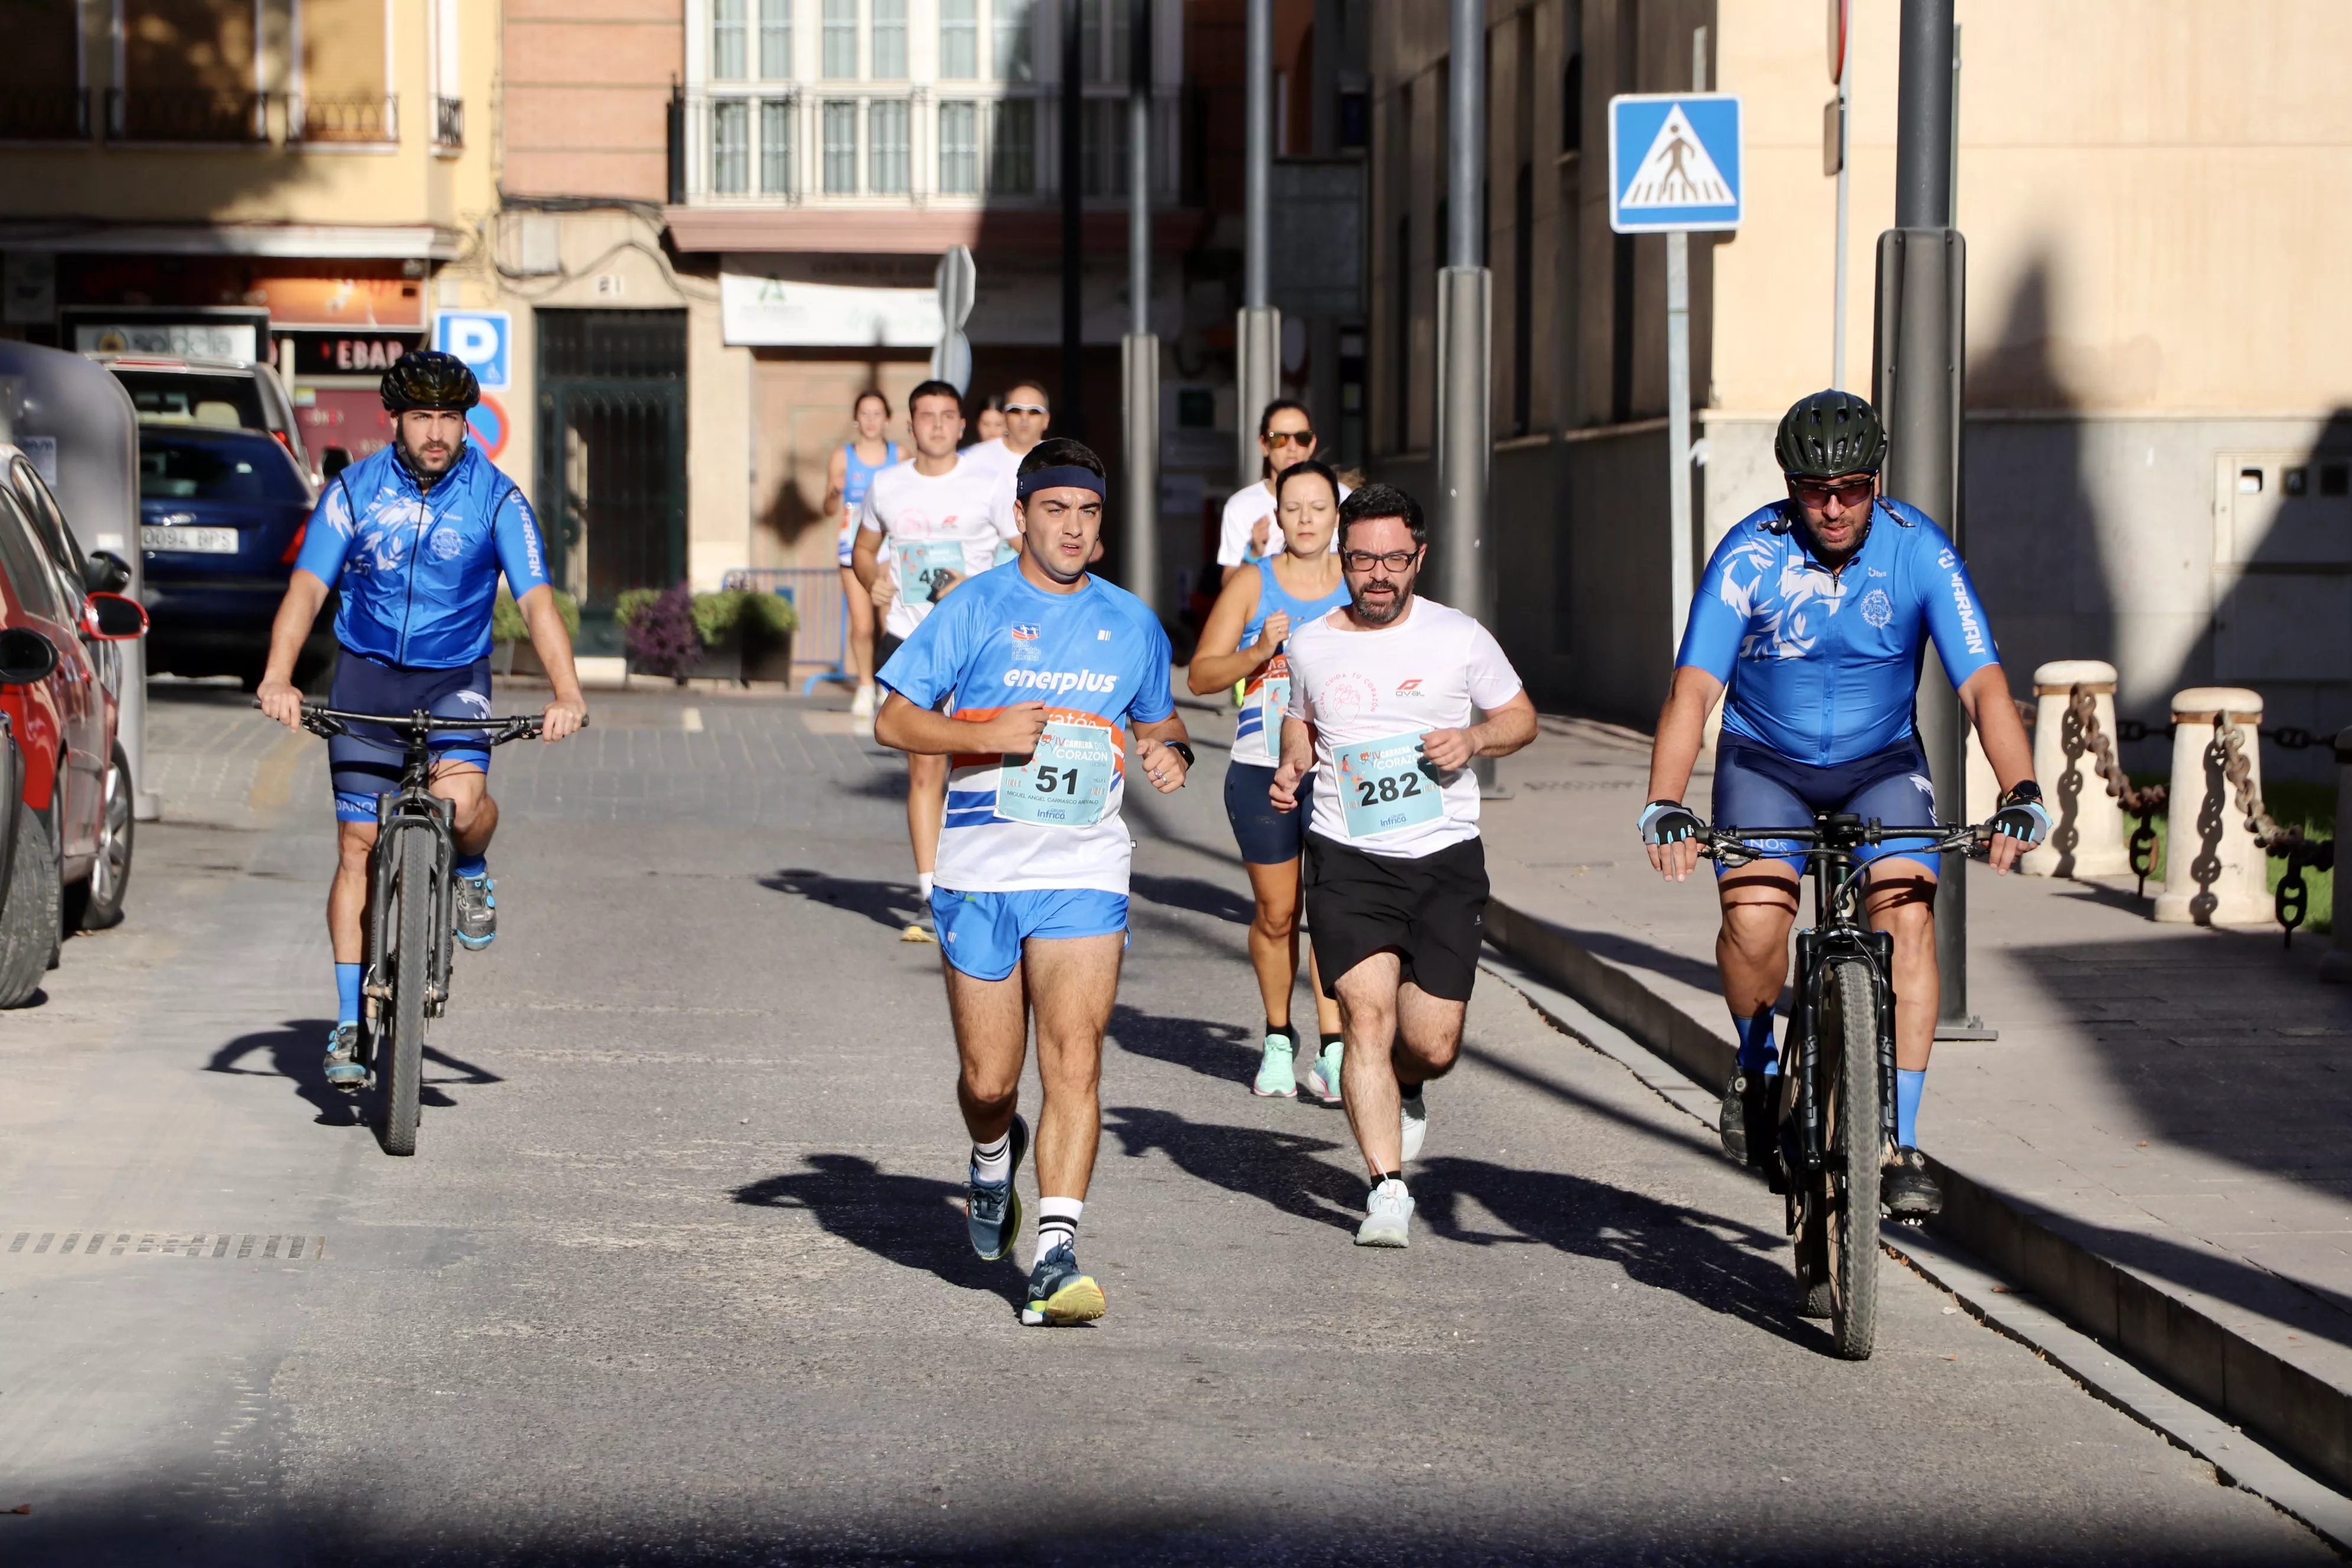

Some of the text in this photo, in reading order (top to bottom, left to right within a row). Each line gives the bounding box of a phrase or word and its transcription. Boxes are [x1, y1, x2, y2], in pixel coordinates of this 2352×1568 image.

[449, 318, 498, 364] P
[1004, 668, 1118, 695] enerplus
[1325, 673, 1347, 687] CUIDA
[1055, 737, 1066, 746] IV
[1064, 739, 1093, 749] CARRERA
[1372, 750, 1381, 759] IV
[1380, 746, 1411, 759] CARRERA
[1035, 765, 1078, 795] 51
[1358, 772, 1422, 806] 282
[1037, 809, 1065, 819] Infrico
[1380, 816, 1406, 827] Infrico
